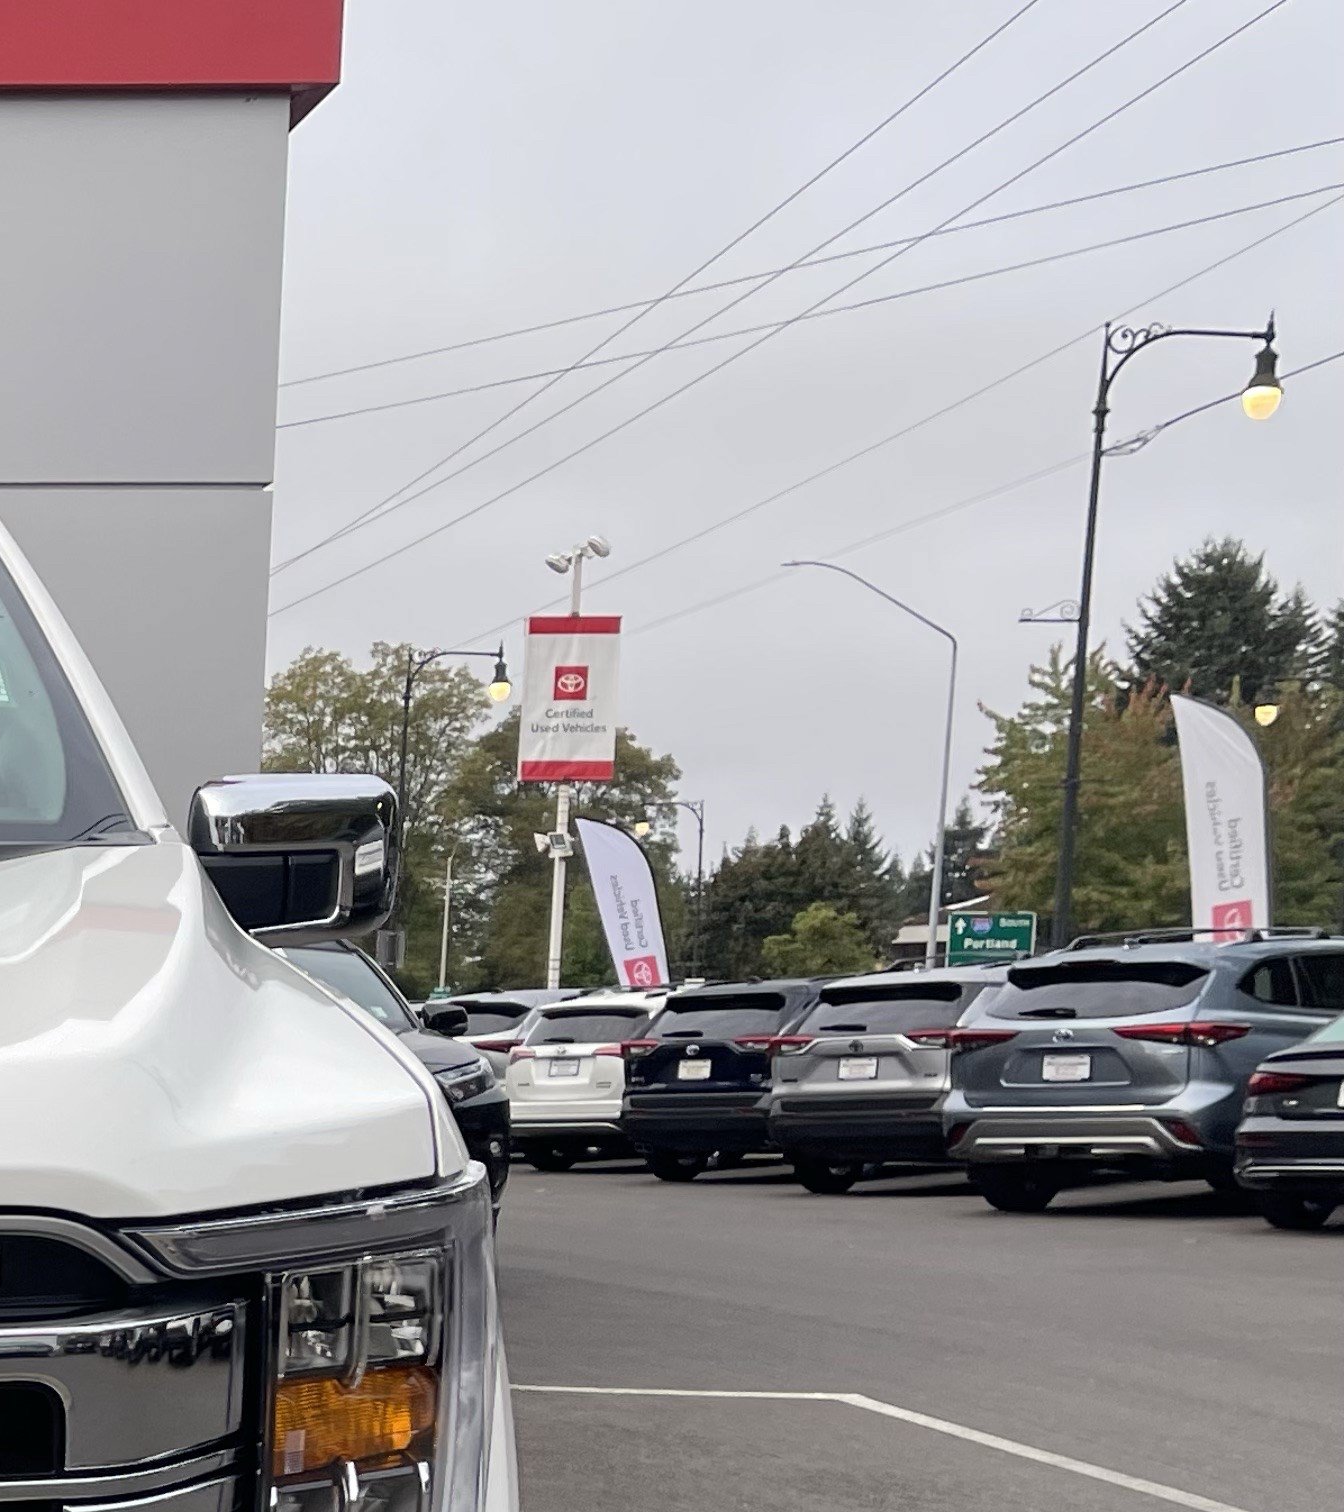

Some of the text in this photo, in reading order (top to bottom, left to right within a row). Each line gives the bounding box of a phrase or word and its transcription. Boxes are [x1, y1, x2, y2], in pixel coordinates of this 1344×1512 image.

[545, 708, 594, 719] Certified
[531, 723, 608, 733] Used Vehicles
[963, 937, 1018, 949] Portland
